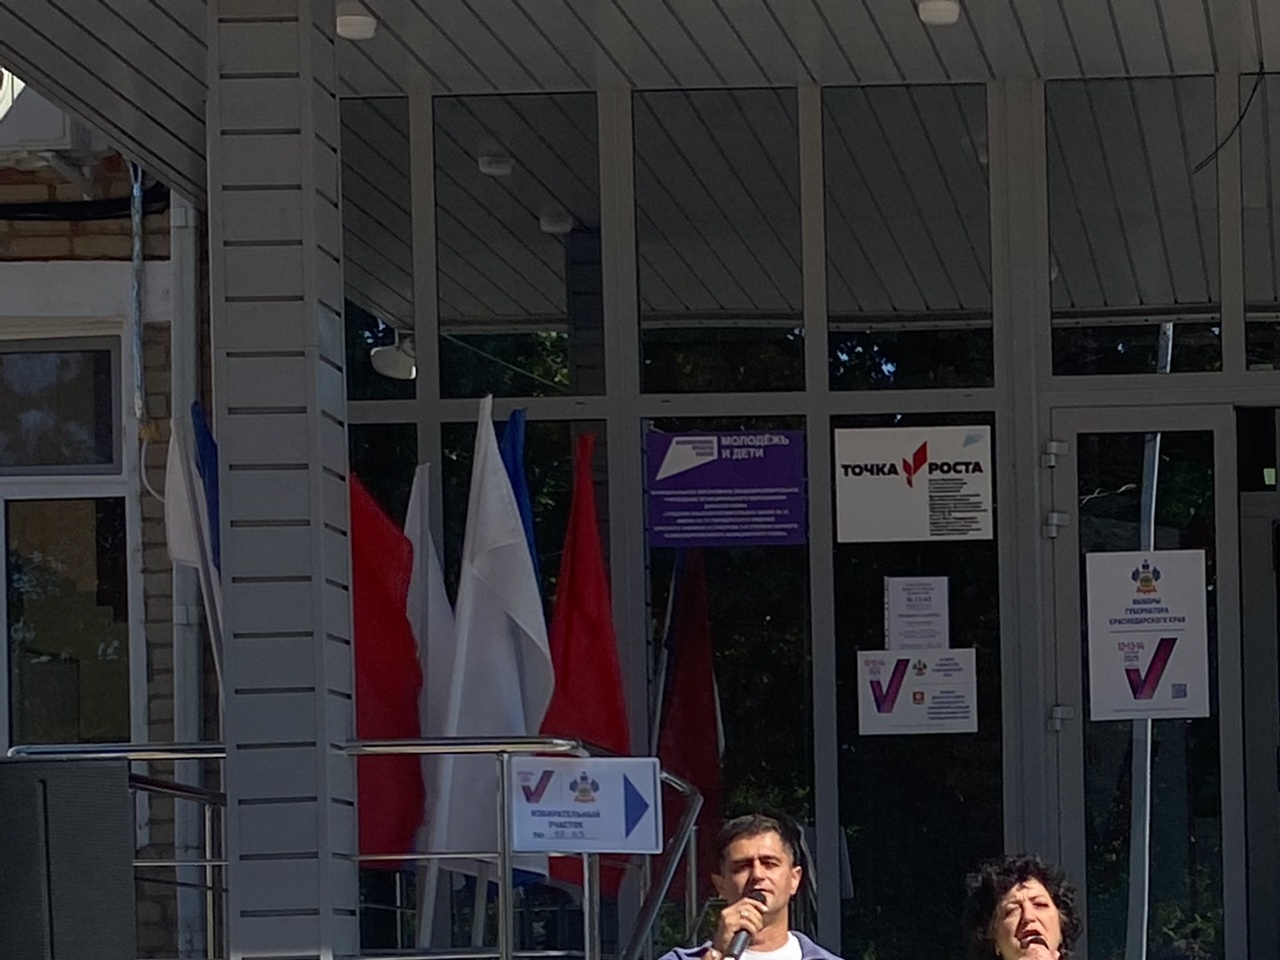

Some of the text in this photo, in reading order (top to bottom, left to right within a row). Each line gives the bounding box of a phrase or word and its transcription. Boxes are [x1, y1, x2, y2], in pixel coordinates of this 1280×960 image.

[721, 448, 730, 459] И
[732, 447, 764, 460] ДЕТИ
[841, 461, 984, 477] ТОЧКА РОСТА
